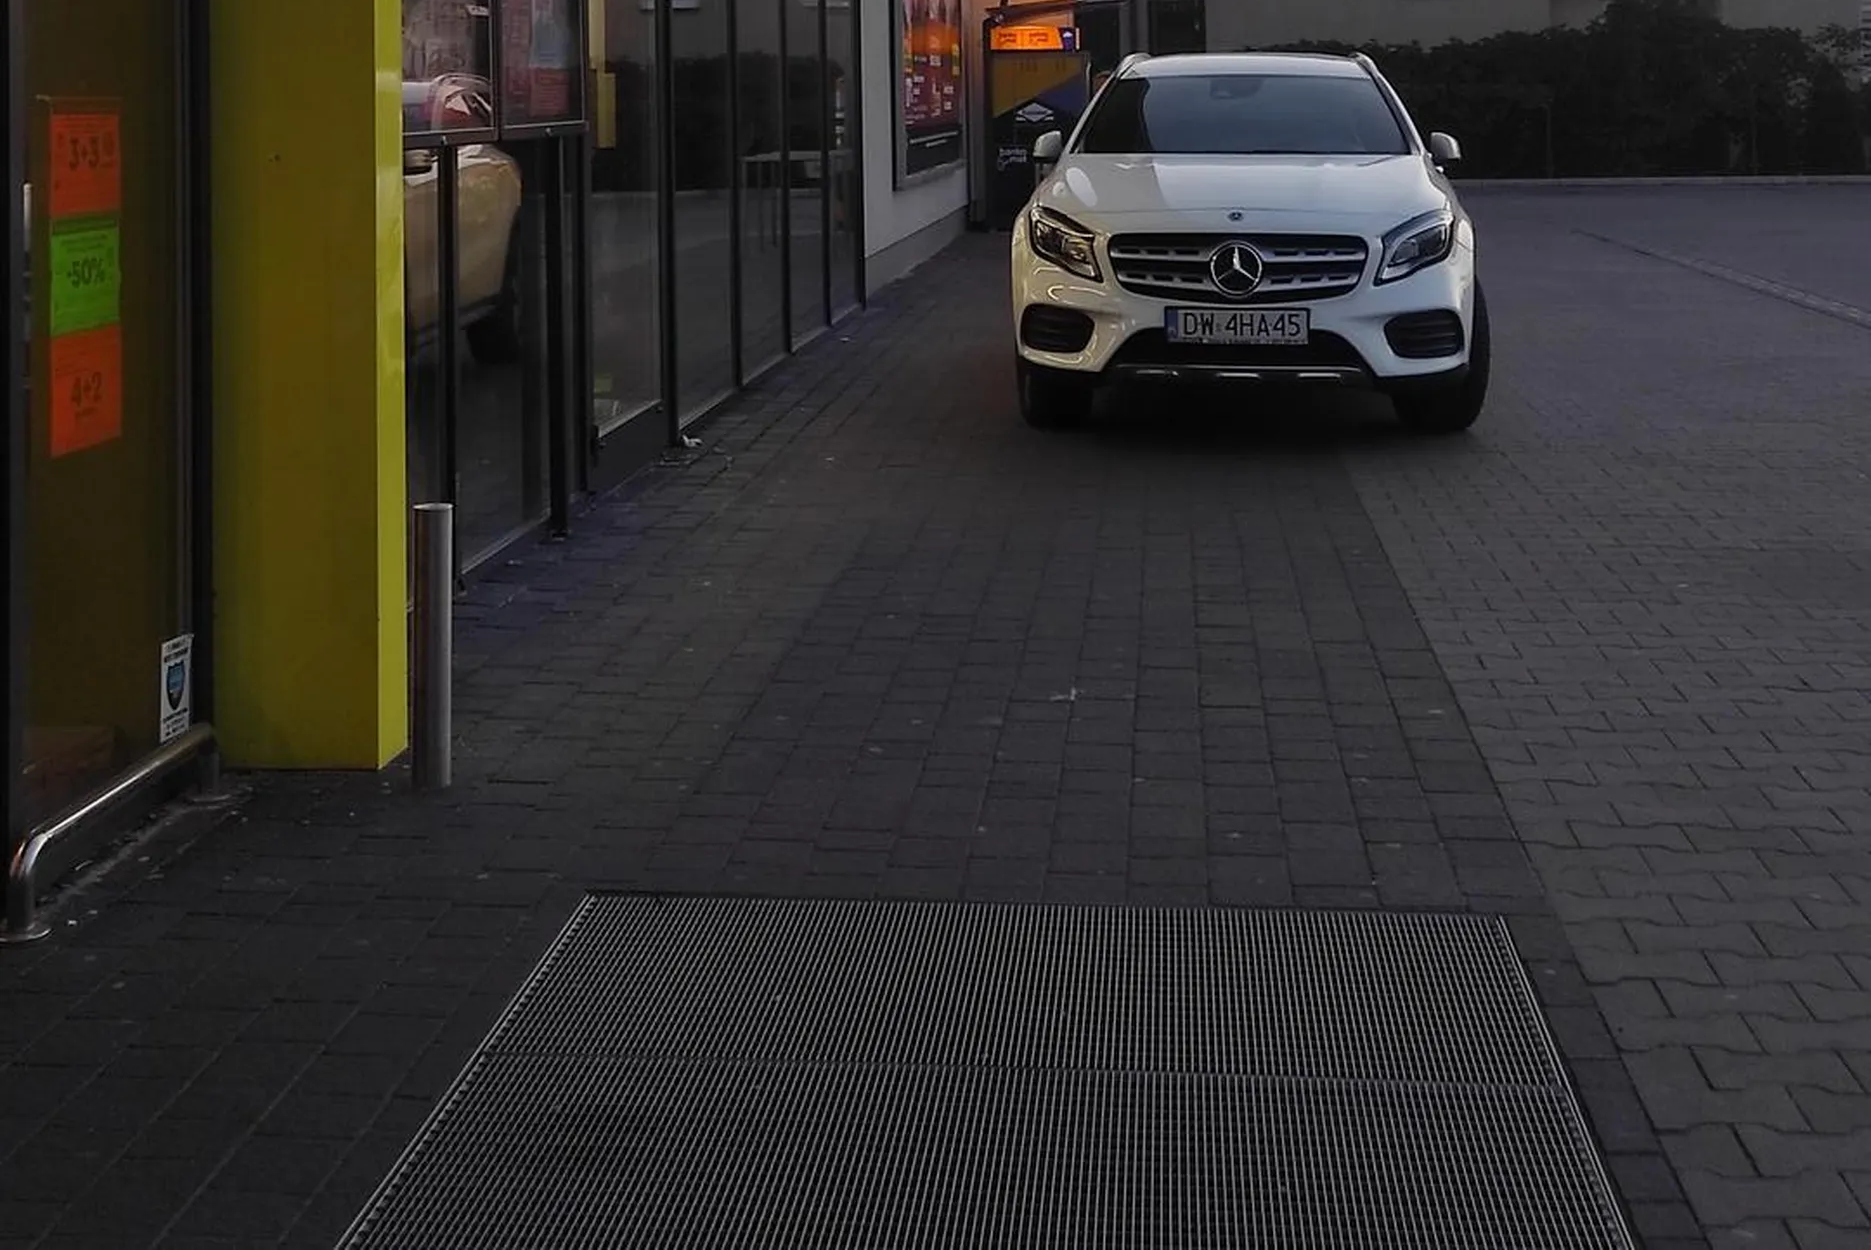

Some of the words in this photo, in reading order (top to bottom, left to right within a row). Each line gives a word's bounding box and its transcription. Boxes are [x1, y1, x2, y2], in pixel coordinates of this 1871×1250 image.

[66, 257, 106, 288] -50%
[1183, 312, 1214, 336] DW
[1225, 313, 1301, 337] 4HA45
